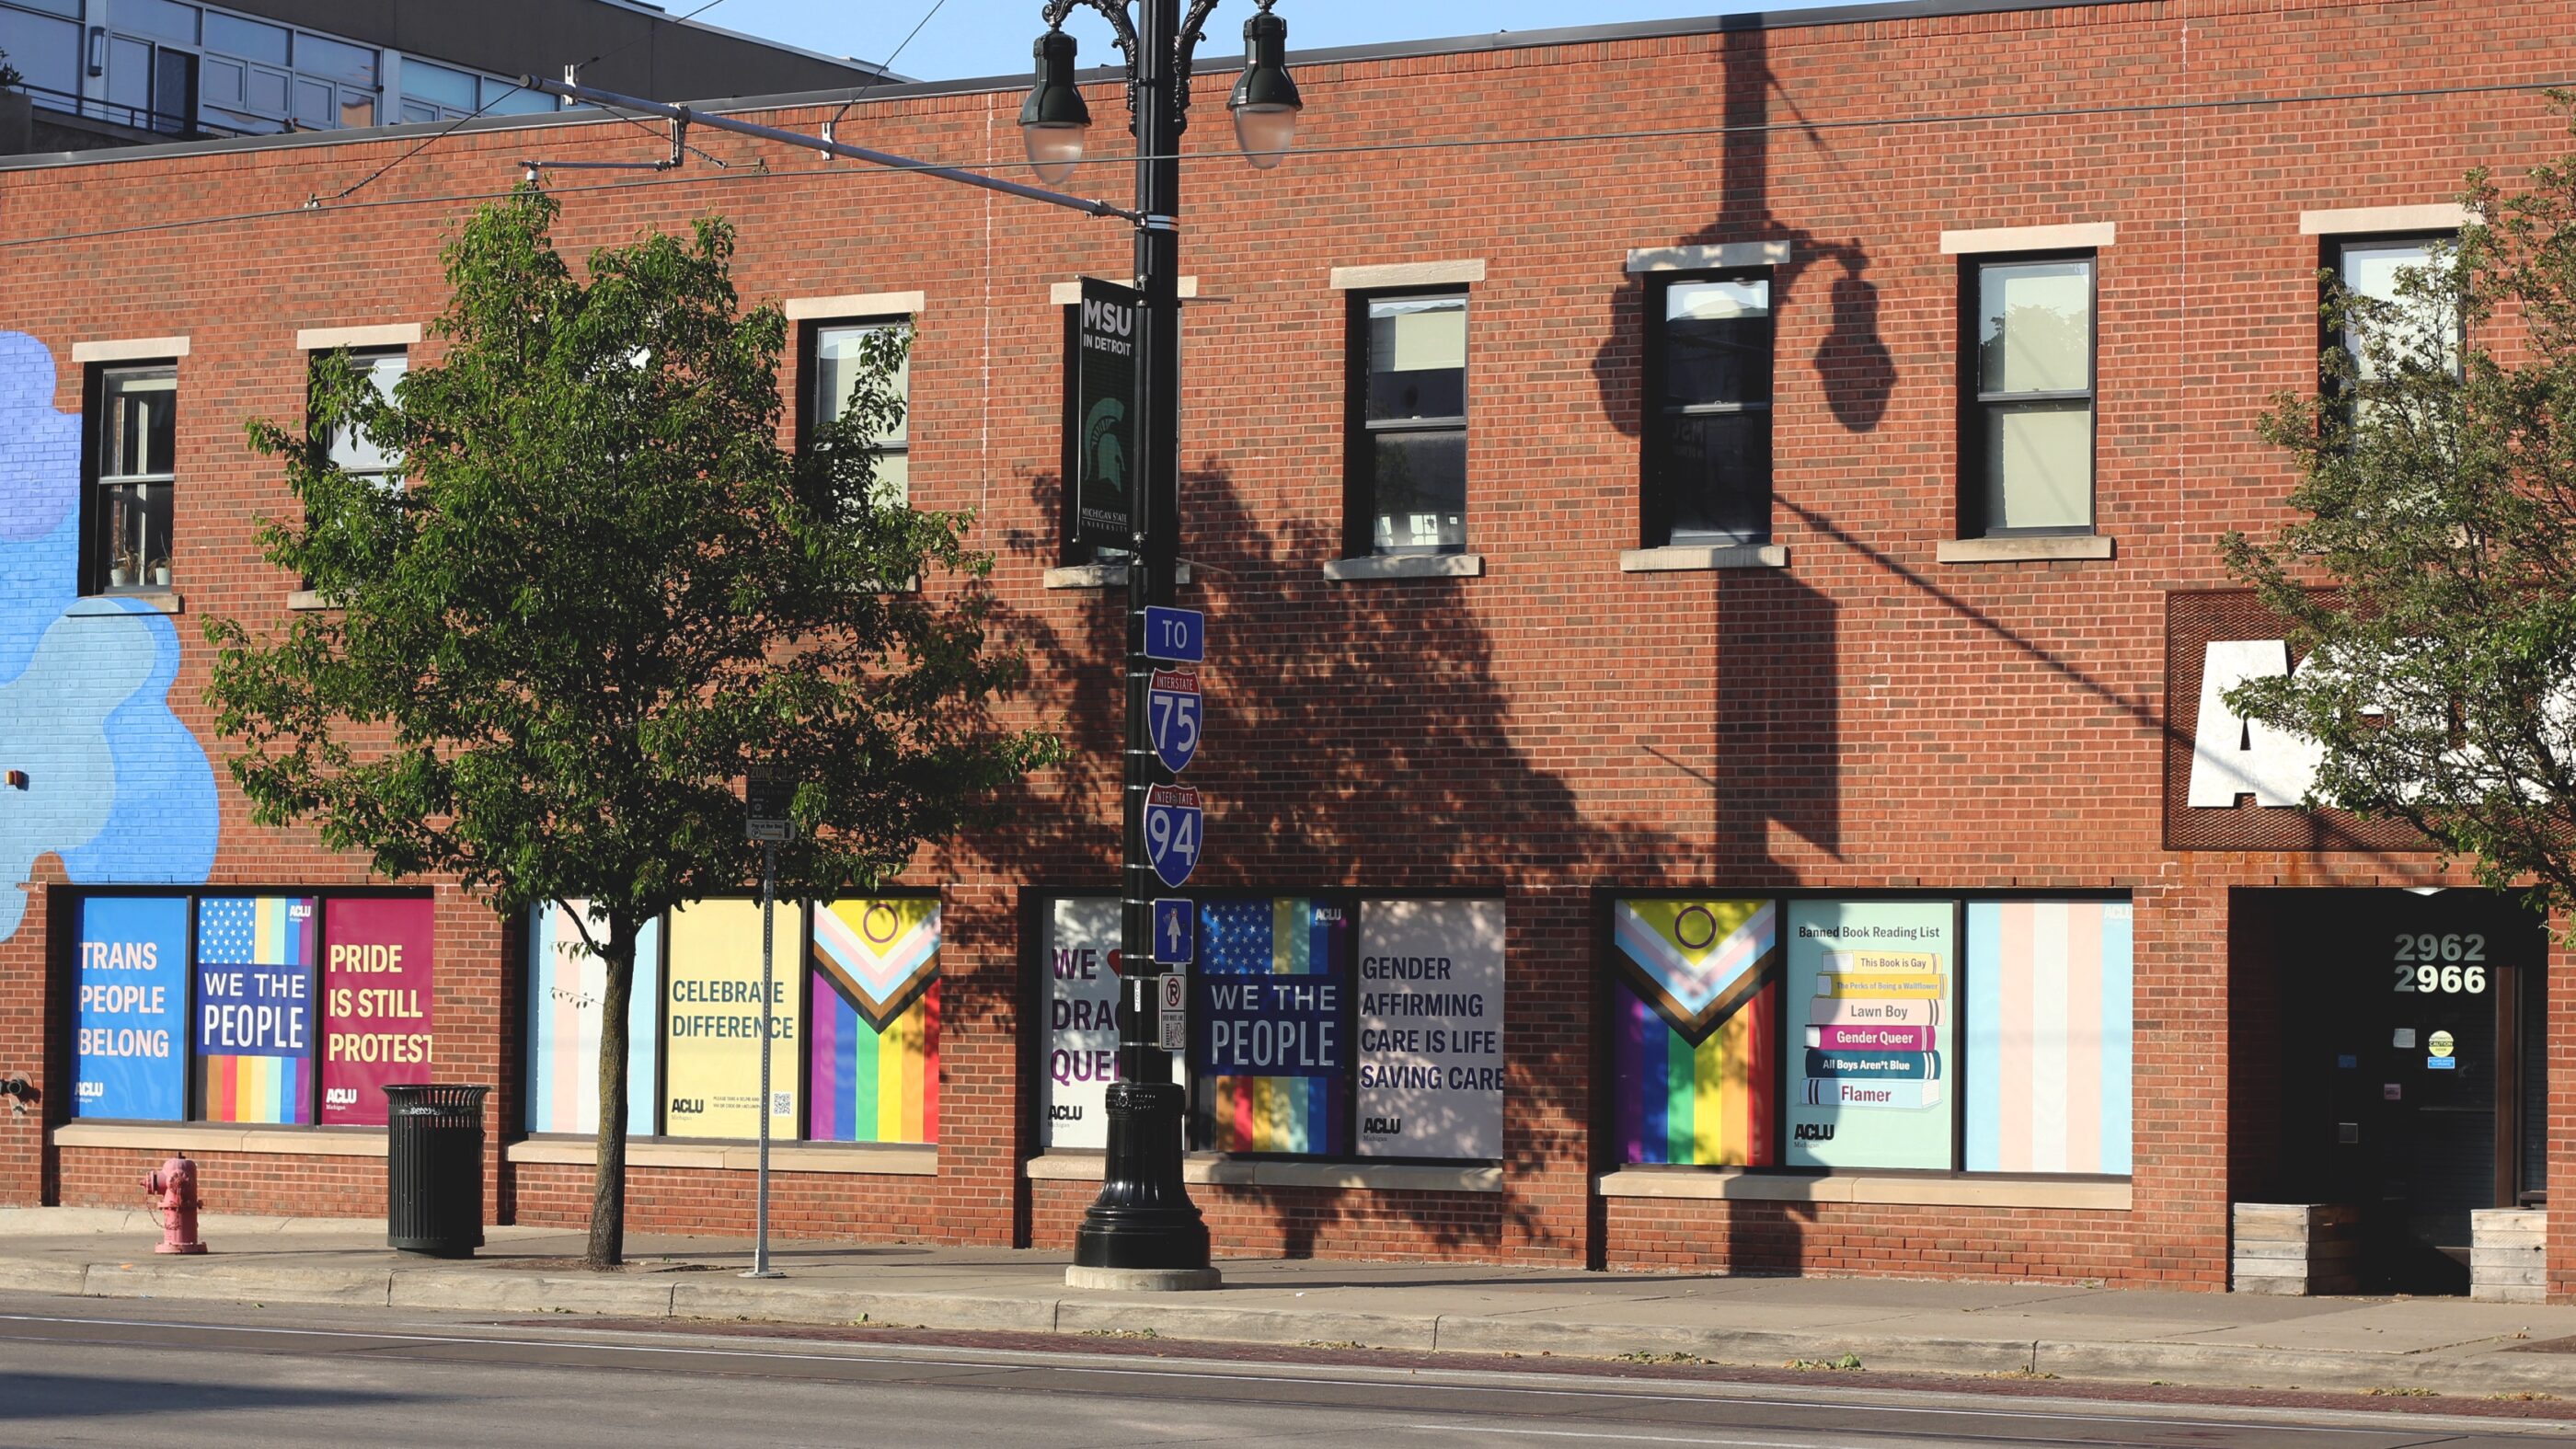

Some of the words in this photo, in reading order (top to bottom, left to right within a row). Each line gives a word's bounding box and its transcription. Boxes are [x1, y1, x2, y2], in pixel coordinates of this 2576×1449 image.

[1084, 298, 1132, 337] MSU
[1083, 333, 1093, 348] IN
[1095, 336, 1132, 357] DETROIT
[1081, 519, 1128, 533] UNIVERSITY
[1082, 507, 1111, 520] MICHIGAN
[1112, 512, 1127, 523] STATE
[1162, 619, 1187, 649] TO
[1156, 675, 1193, 691] INTERSTATE
[1154, 696, 1196, 752] 75
[1150, 810, 1195, 866] 94
[290, 905, 311, 917] ACLU
[1315, 908, 1341, 920] ACLU
[1800, 926, 1839, 937] Banned
[1843, 926, 1869, 937] Book
[1873, 926, 1917, 940] Reading
[1920, 926, 1939, 937] List
[79, 942, 157, 971] TRANS
[330, 944, 402, 972] PRIDE
[2394, 933, 2486, 961] 2962
[1052, 949, 1097, 980] WE
[1362, 957, 1451, 980] GENDER
[1860, 958, 1878, 967] This
[1880, 958, 1900, 967] Book
[1903, 958, 1908, 967] is
[1911, 958, 1926, 970] Gay
[204, 972, 243, 996] WE
[254, 973, 305, 998] THE
[1878, 983, 1896, 991] Being
[2394, 964, 2486, 994] 2966
[78, 985, 165, 1014] PEOPLE
[673, 980, 784, 1003] CELEBRAE
[1211, 984, 1259, 1010] WE
[1272, 984, 1336, 1010] THE
[329, 989, 352, 1018] IS
[357, 989, 423, 1018] STILL
[1362, 993, 1483, 1018] AFFIRMING
[1851, 1005, 1882, 1018] Lawn
[1886, 1005, 1908, 1020] Boy
[203, 1005, 304, 1048] PEOPLE
[673, 1016, 793, 1039] DIFFERENCE
[1836, 1031, 1877, 1043] Gender
[1880, 1031, 1914, 1045] Queer
[78, 1029, 169, 1058] BELONG
[328, 1033, 432, 1064] PROTEST
[1212, 1019, 1335, 1066] PEOPLE
[1362, 1029, 1419, 1052] CARE
[1426, 1029, 1445, 1053] IS
[1452, 1030, 1496, 1054] LIFE
[1823, 1060, 1835, 1069] All
[1836, 1060, 1858, 1072] Boys
[1859, 1060, 1889, 1070] Aren't
[1890, 1060, 1910, 1070] Blue
[75, 1082, 103, 1097] ACLU
[1361, 1065, 1443, 1090] SAVING
[1448, 1066, 1503, 1091] CARE
[327, 1088, 357, 1104] ACLU
[1841, 1086, 1892, 1102] Flamer
[672, 1098, 704, 1114] ACLU
[1048, 1105, 1083, 1121] ACLU
[1363, 1117, 1401, 1134] ACLU
[1794, 1123, 1834, 1141] ACLU
